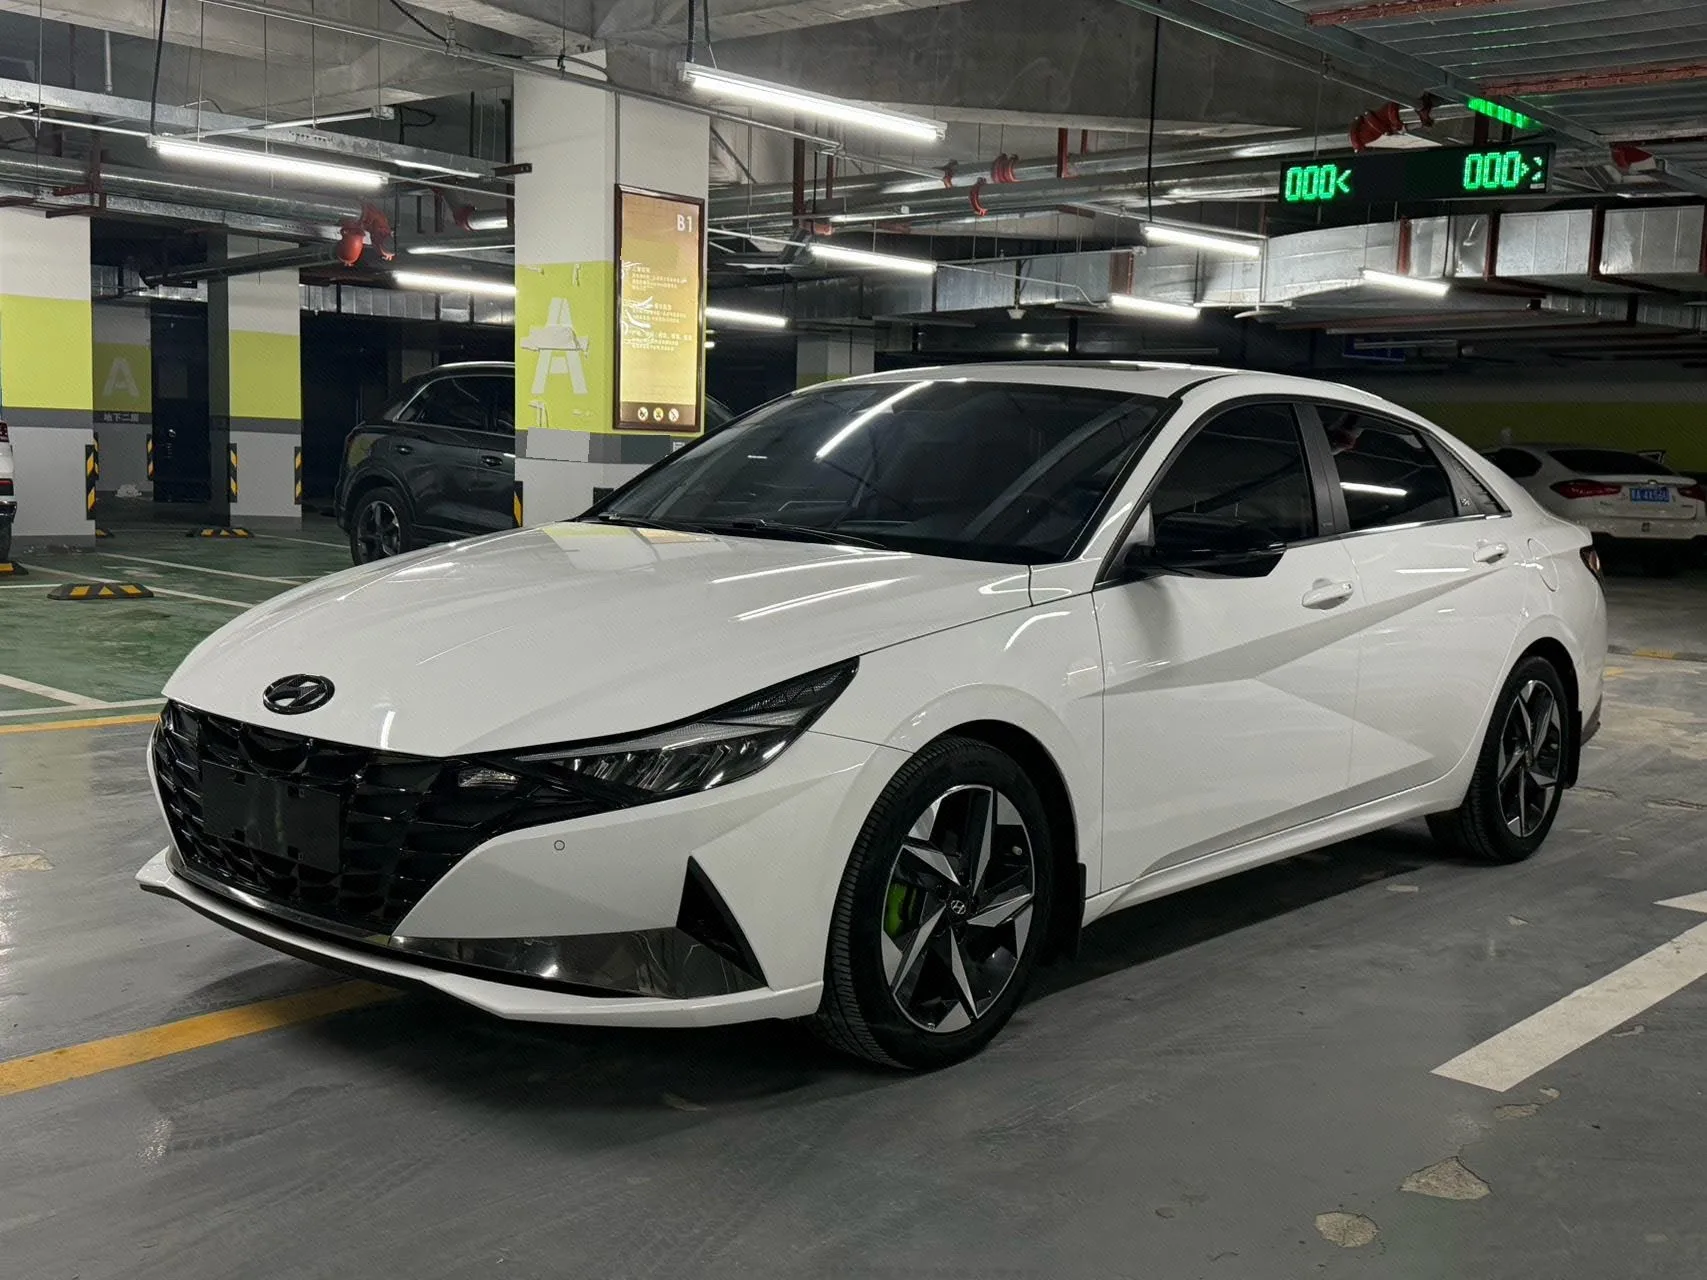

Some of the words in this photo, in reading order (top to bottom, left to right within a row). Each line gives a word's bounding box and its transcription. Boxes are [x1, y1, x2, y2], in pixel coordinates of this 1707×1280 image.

[677, 214, 692, 232] B1
[531, 297, 590, 394] A
[102, 357, 139, 397] A
